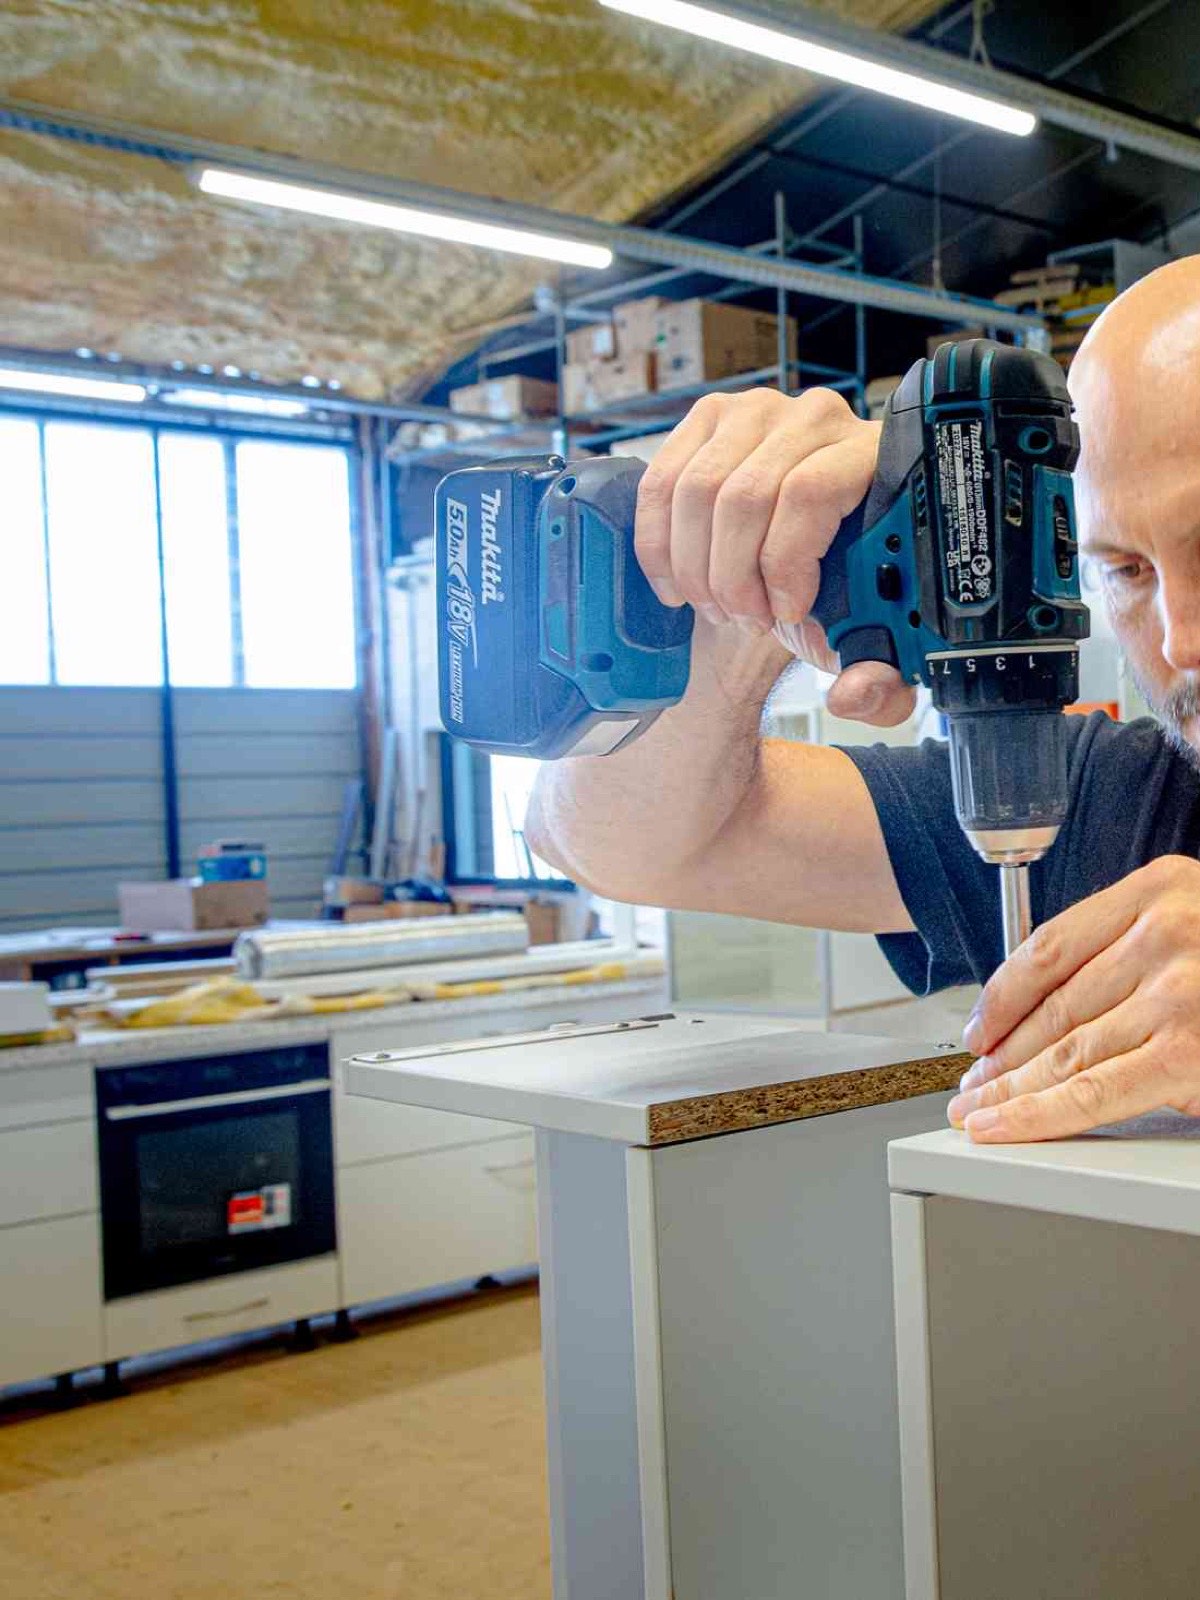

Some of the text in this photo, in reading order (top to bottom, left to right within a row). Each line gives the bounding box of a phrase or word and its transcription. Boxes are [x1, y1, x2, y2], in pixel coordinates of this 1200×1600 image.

[449, 505, 465, 559] 5.0Ah
[975, 509, 988, 552] DDF482
[480, 489, 503, 604] Makita
[446, 583, 474, 647] 18V
[942, 660, 952, 674] 7
[965, 658, 976, 672] 5
[995, 656, 1006, 670] 3
[1028, 655, 1036, 669] 1
